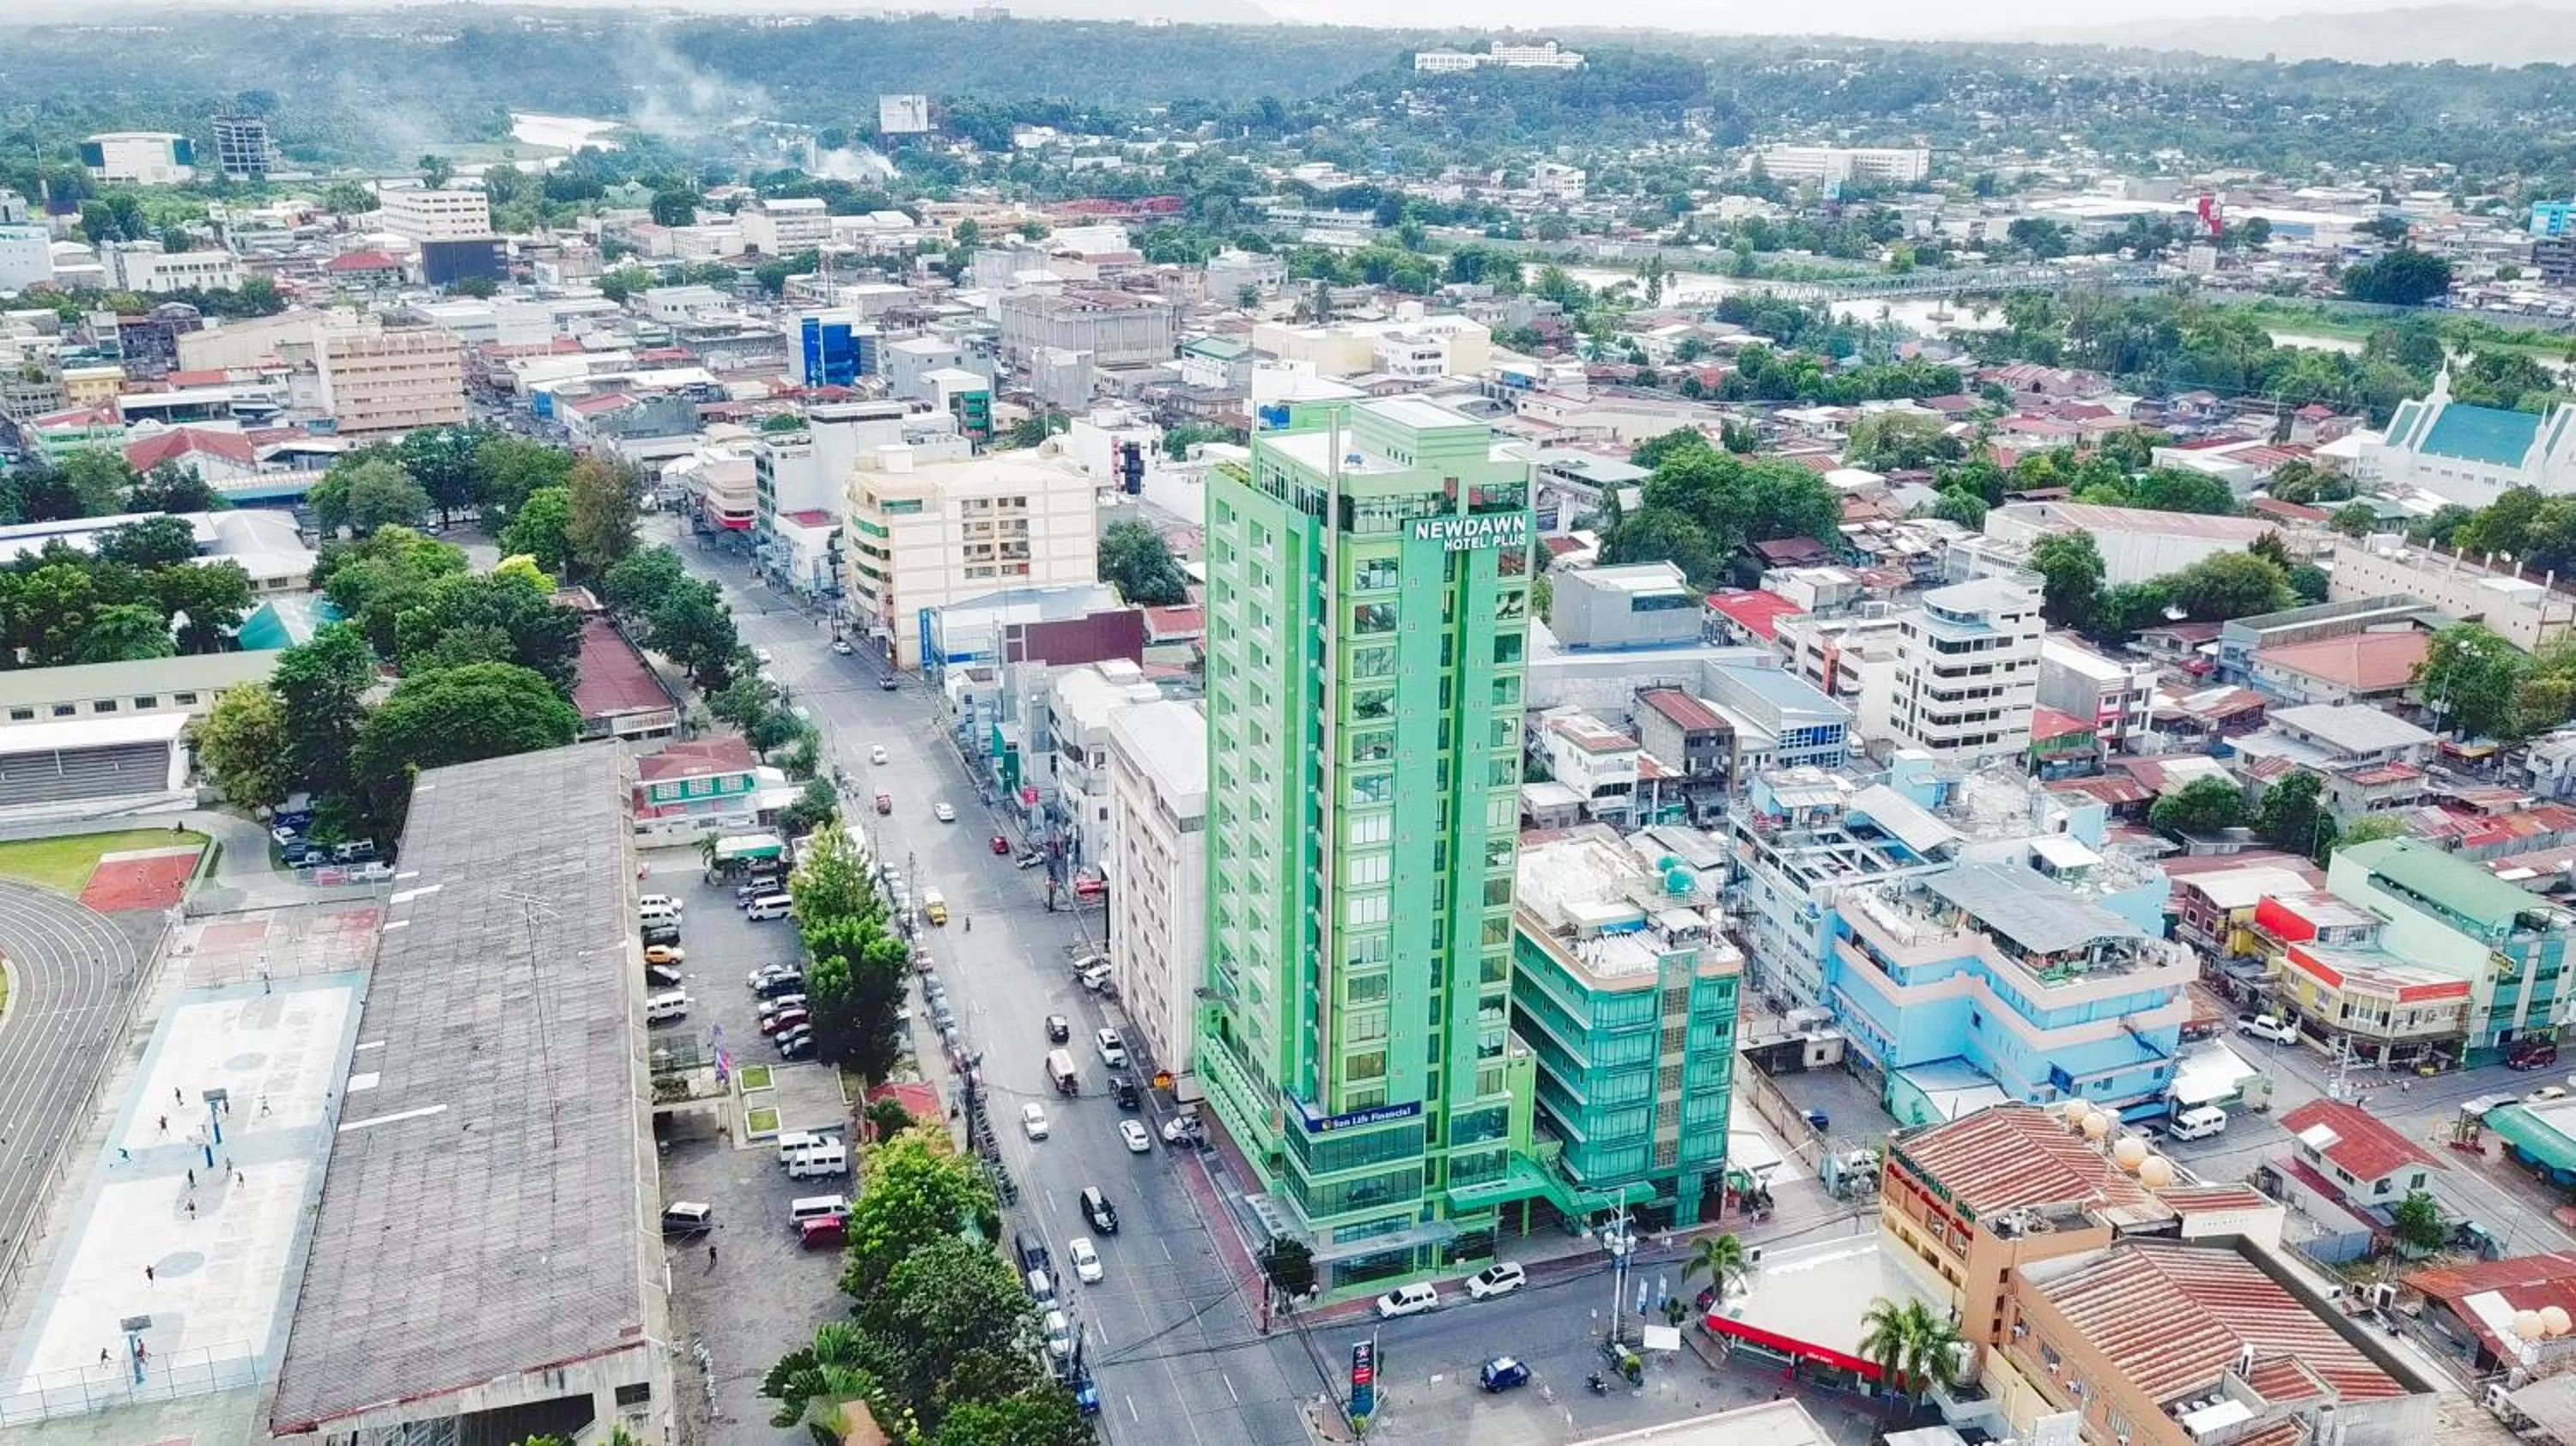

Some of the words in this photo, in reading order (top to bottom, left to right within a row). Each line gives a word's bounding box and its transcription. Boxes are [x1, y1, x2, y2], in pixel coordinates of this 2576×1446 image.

[1415, 514, 1527, 541] NEWDAWN
[1443, 536, 1488, 551] HOTEL
[1492, 533, 1527, 547] PLUS
